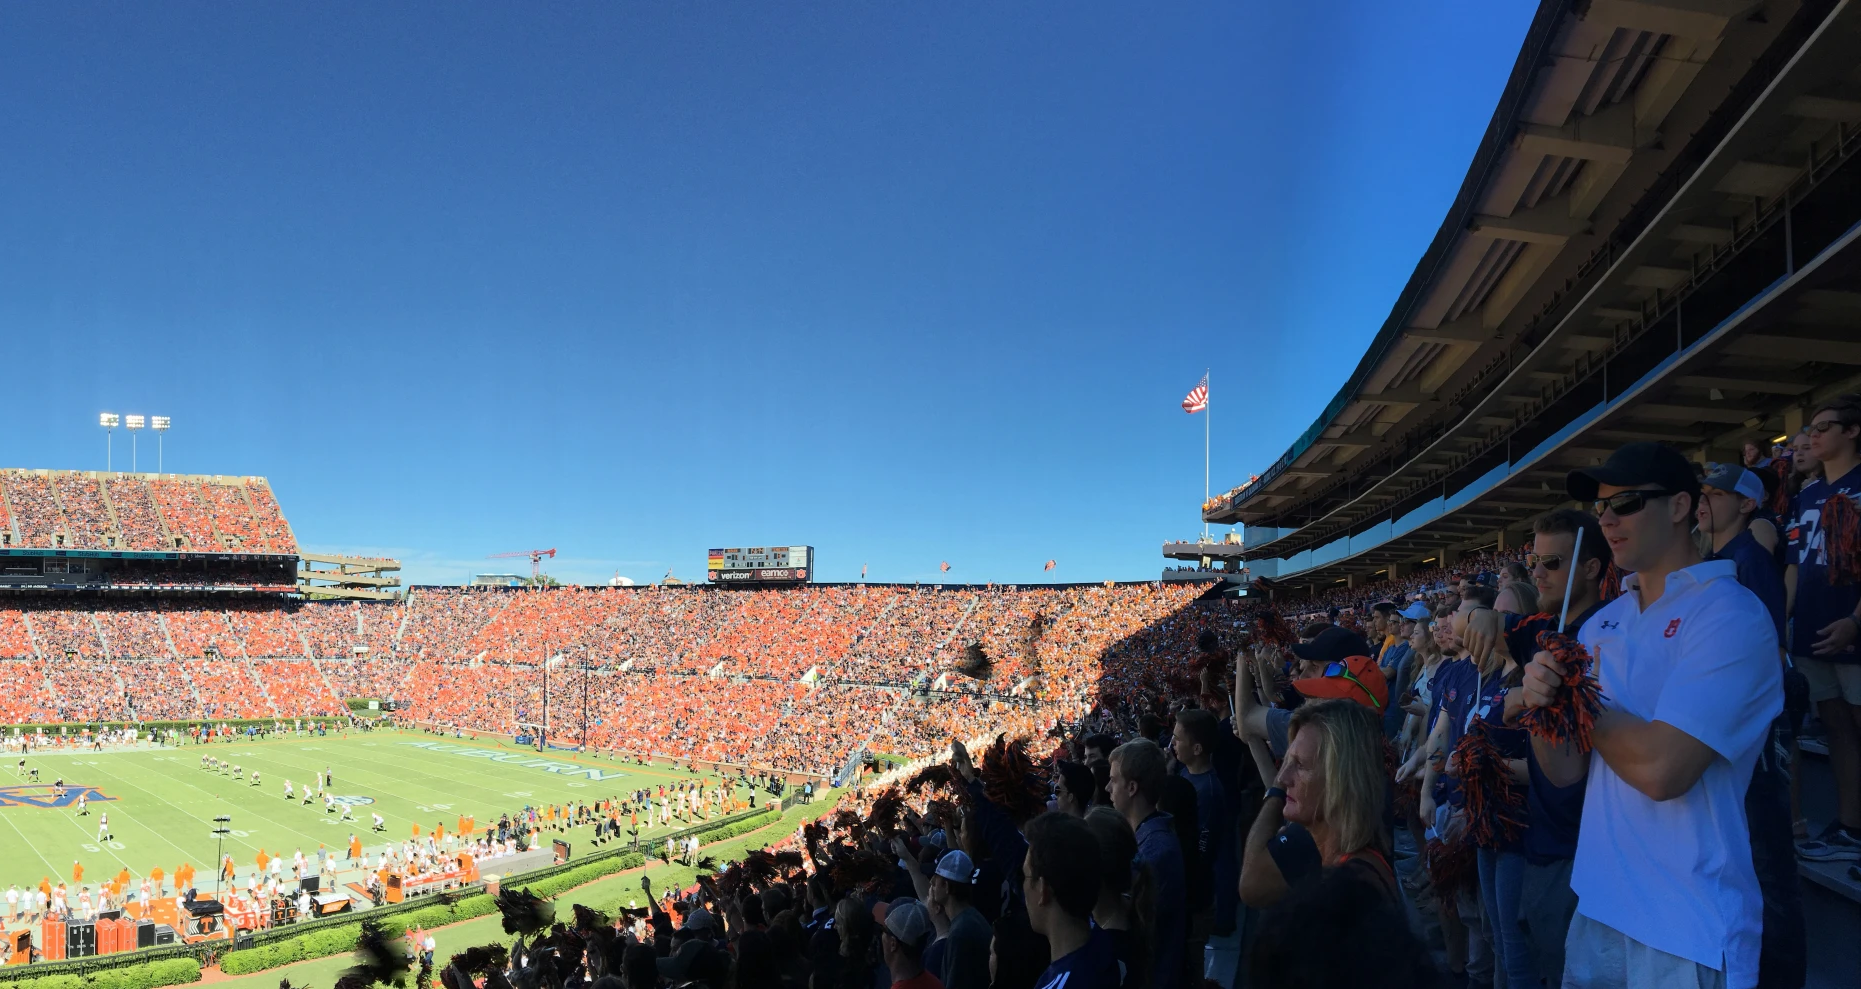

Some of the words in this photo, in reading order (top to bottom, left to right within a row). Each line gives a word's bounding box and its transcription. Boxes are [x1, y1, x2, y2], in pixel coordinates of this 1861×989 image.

[721, 570, 750, 580] verizon
[396, 741, 632, 782] AUBURN
[199, 916, 214, 933] T
